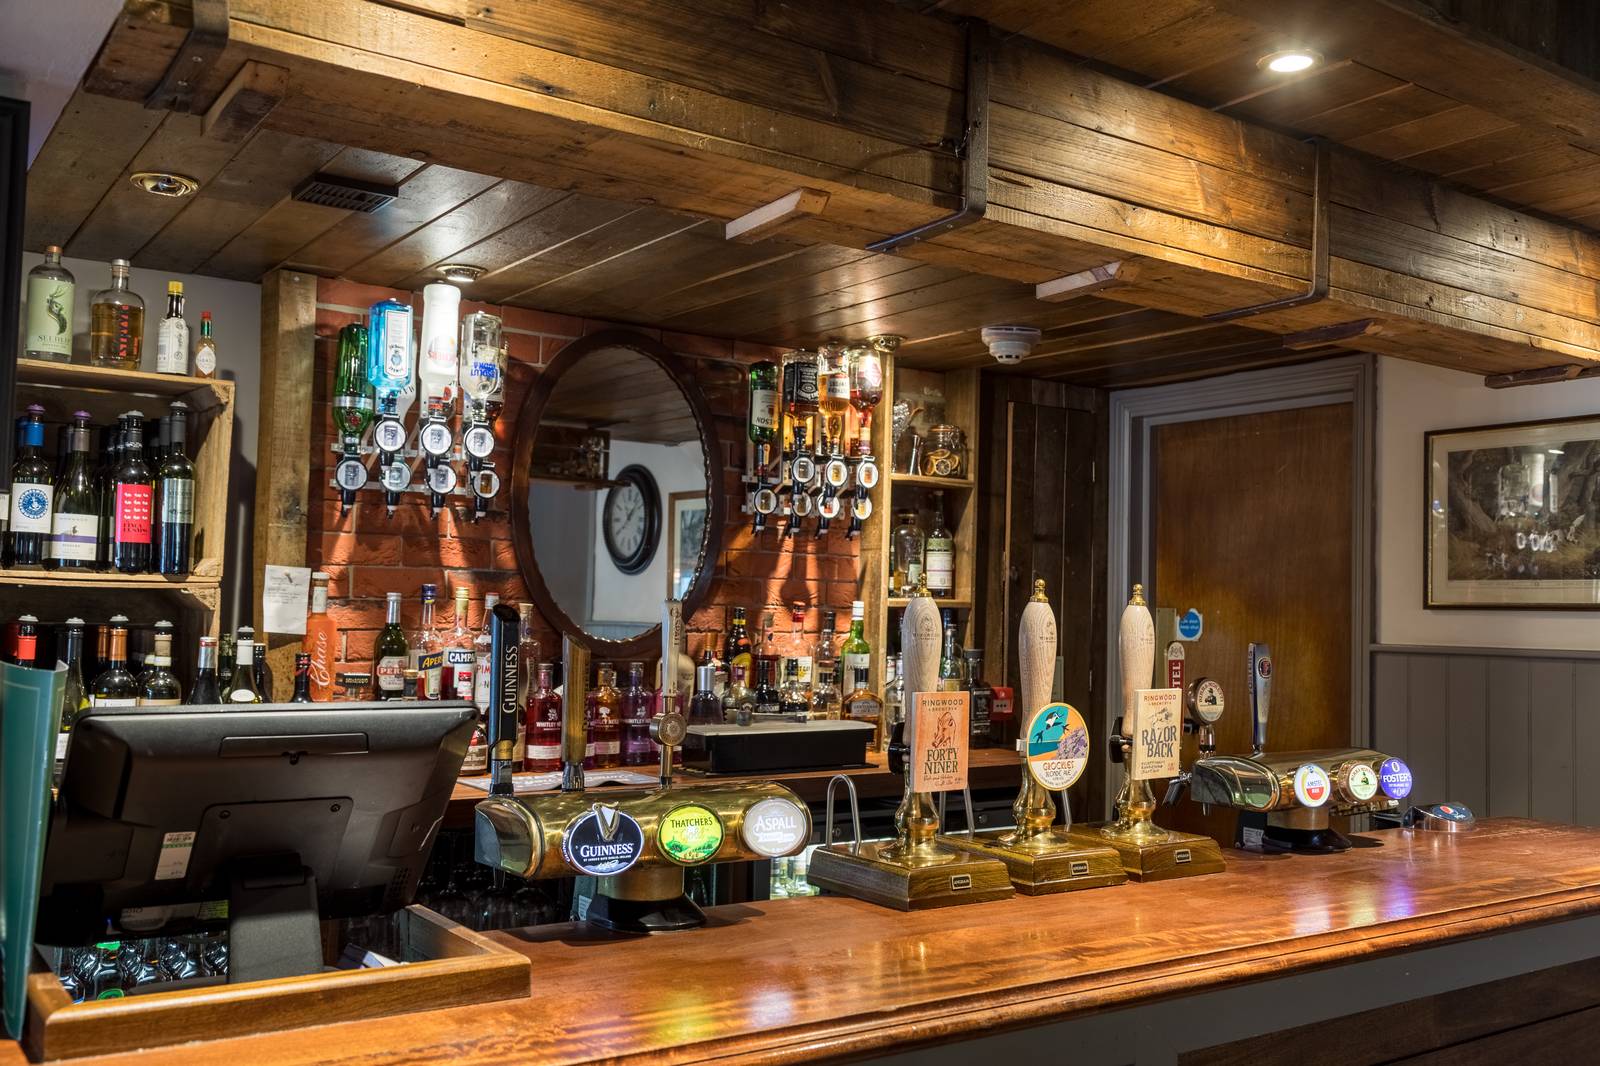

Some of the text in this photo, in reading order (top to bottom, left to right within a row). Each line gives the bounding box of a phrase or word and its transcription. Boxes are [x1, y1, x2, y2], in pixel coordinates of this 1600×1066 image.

[757, 416, 773, 425] ESON
[422, 656, 443, 668] APER
[449, 652, 475, 663] CAMPA
[502, 646, 518, 713] GUINNESS
[1172, 662, 1181, 689] TEL
[1141, 725, 1177, 746] RAZOR
[927, 748, 960, 762] FORTY
[1147, 743, 1173, 758] BACK
[924, 761, 958, 775] NINER
[1307, 779, 1323, 787] AMSTEL
[670, 816, 713, 828] THATCHERS
[754, 815, 797, 831] ASPALL
[580, 843, 633, 857] GUINNESS
